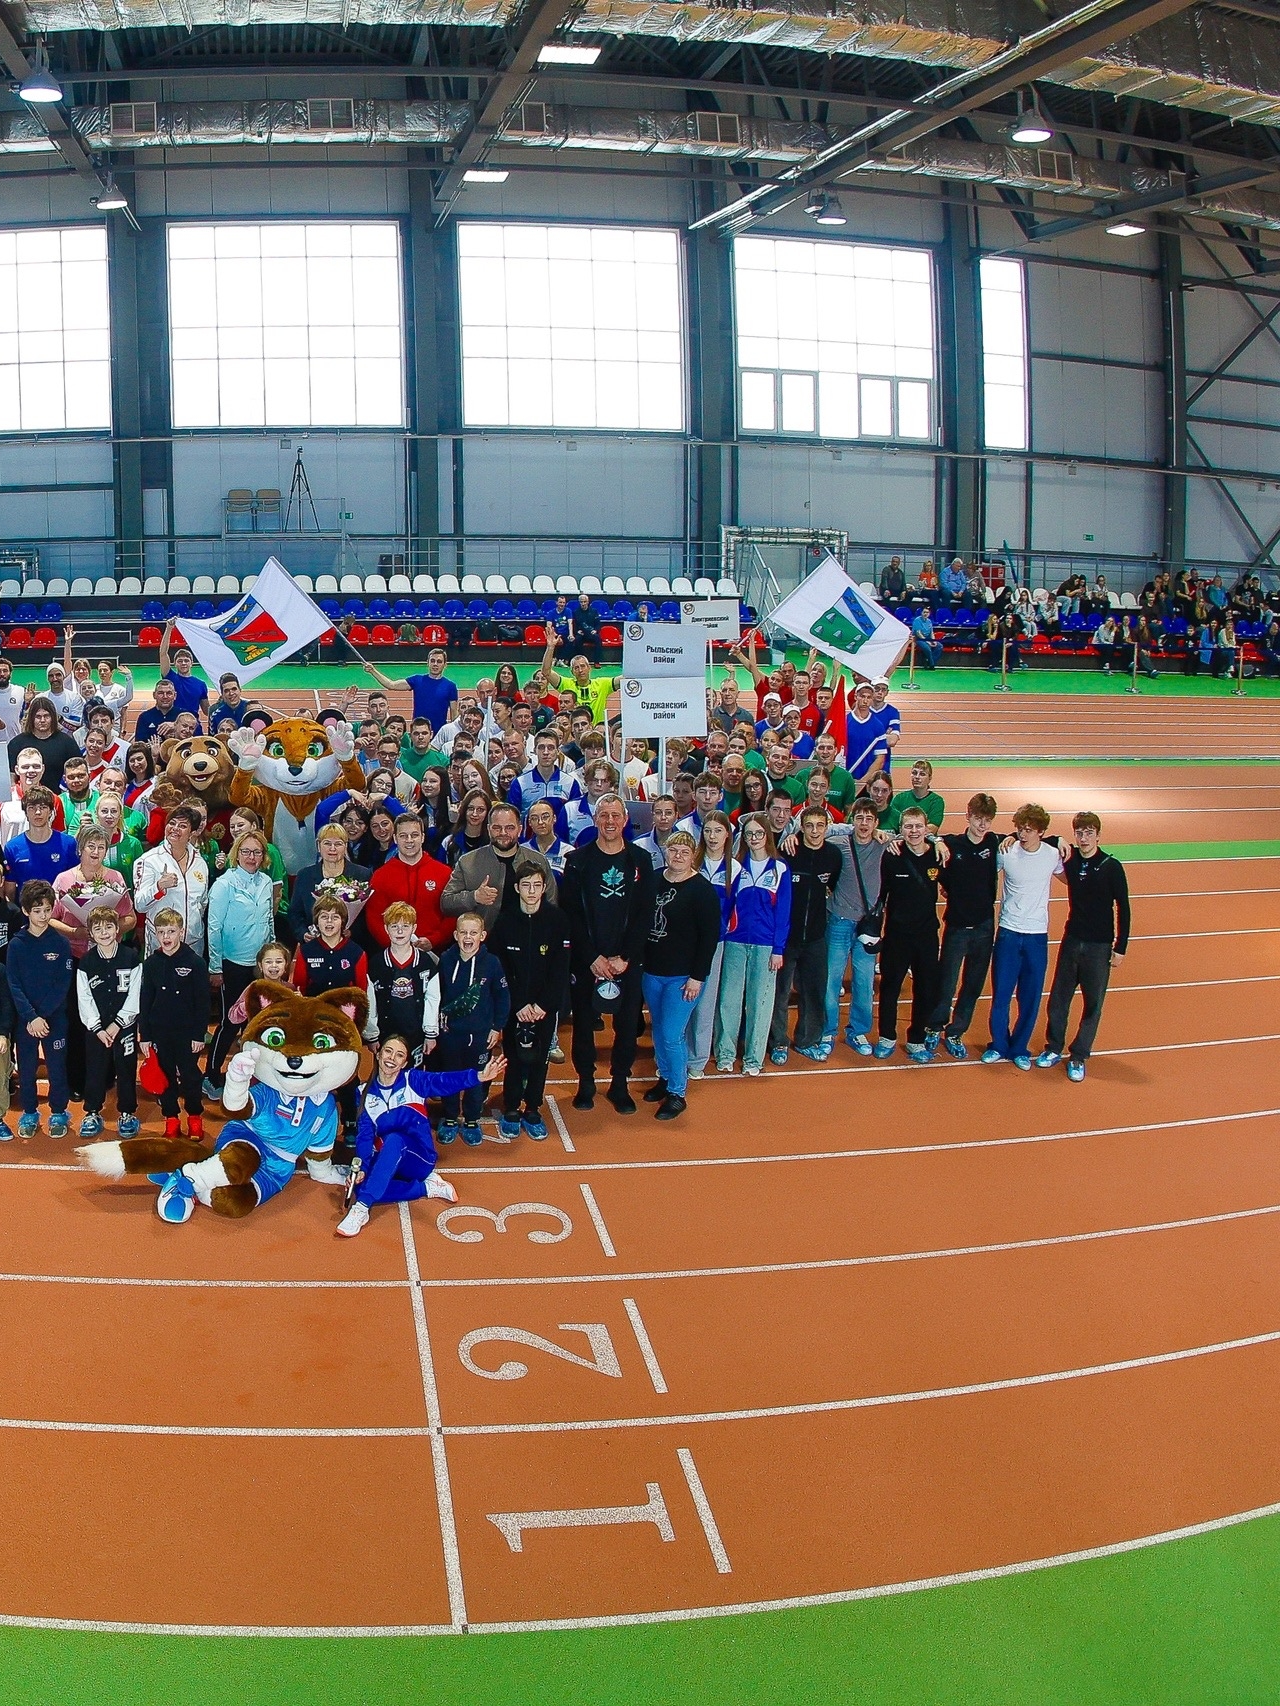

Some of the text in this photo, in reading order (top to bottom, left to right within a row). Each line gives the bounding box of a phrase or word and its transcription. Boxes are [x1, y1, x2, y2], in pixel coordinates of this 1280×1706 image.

[646, 645, 683, 654] Рыльский
[653, 655, 675, 664] район
[640, 700, 688, 710] Суджанский
[653, 711, 676, 720] район
[791, 874, 801, 883] 26
[436, 1202, 574, 1244] 3
[457, 1323, 623, 1381] 2
[485, 1482, 676, 1553] 1
